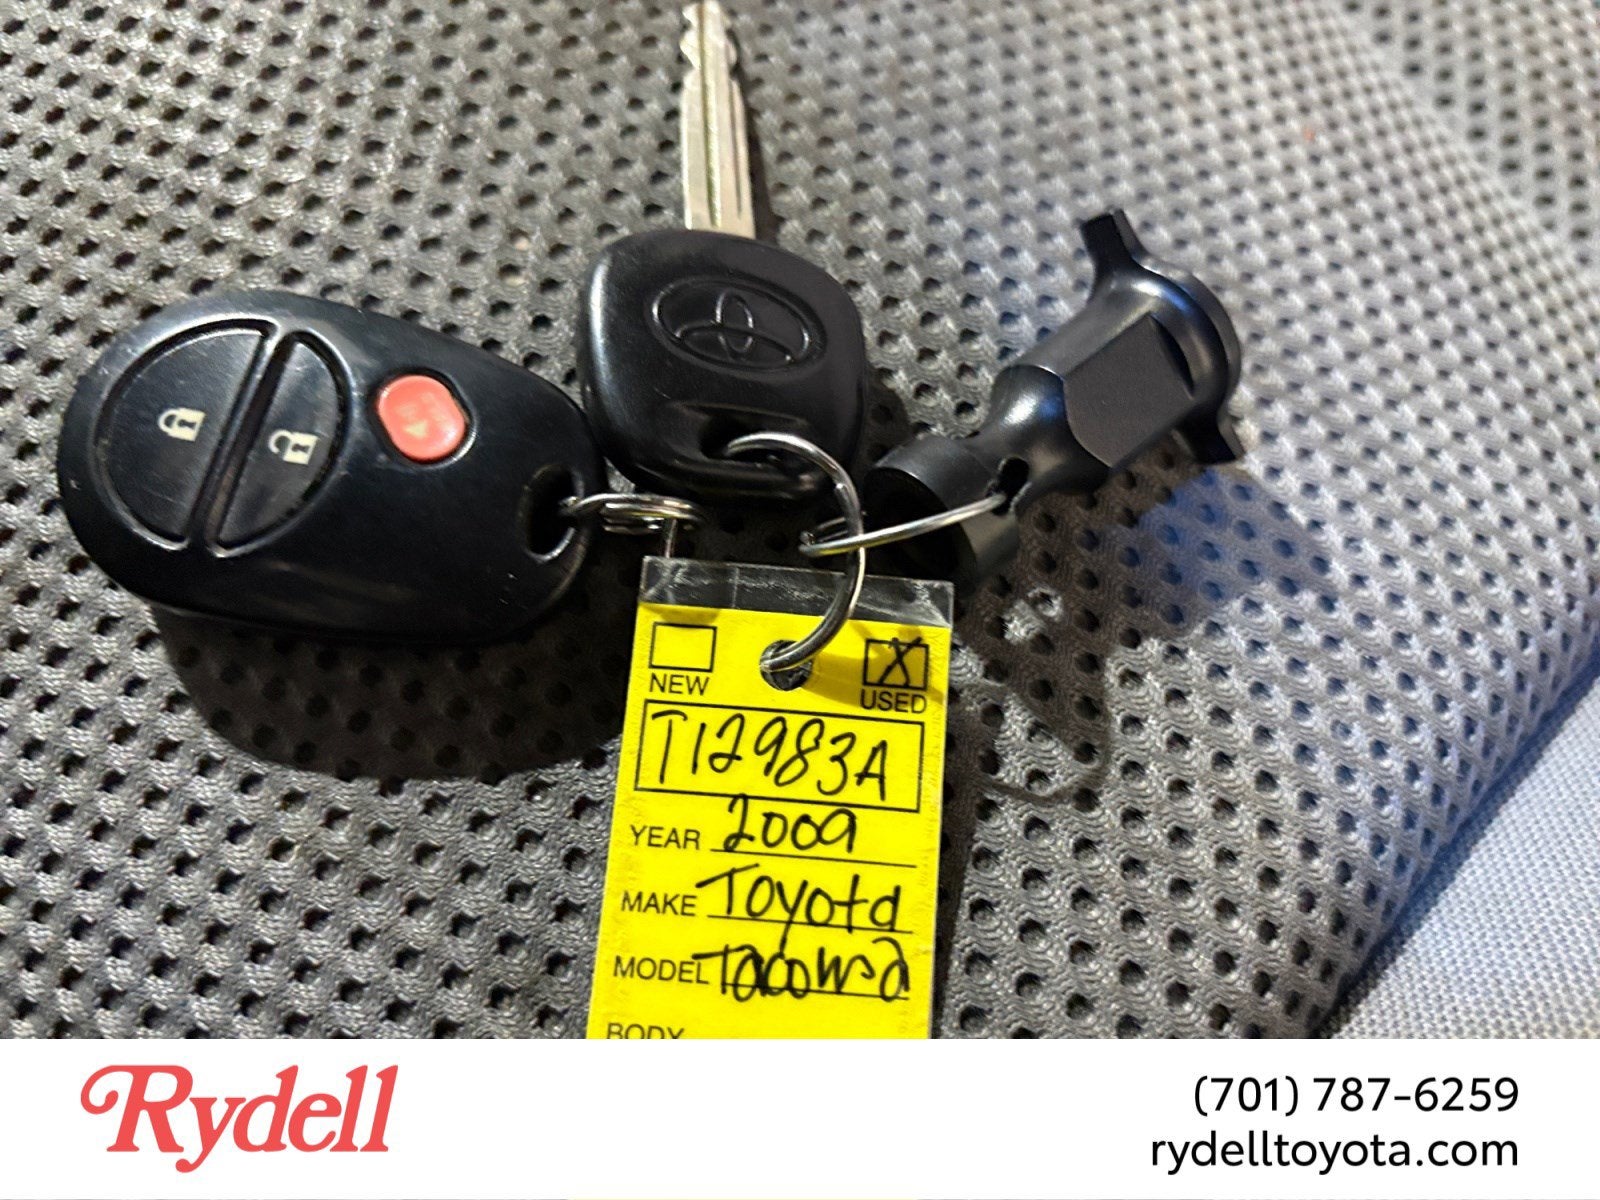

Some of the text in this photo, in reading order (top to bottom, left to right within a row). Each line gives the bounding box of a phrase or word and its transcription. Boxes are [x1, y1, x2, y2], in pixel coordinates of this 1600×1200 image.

[649, 674, 709, 696] NEW
[860, 688, 928, 714] USED
[651, 710, 888, 801] T12983A
[630, 825, 701, 850] YEAR
[724, 794, 857, 853] 2009
[621, 891, 698, 917] MAKE
[695, 863, 902, 958] Toyota
[613, 955, 709, 985] MODEL
